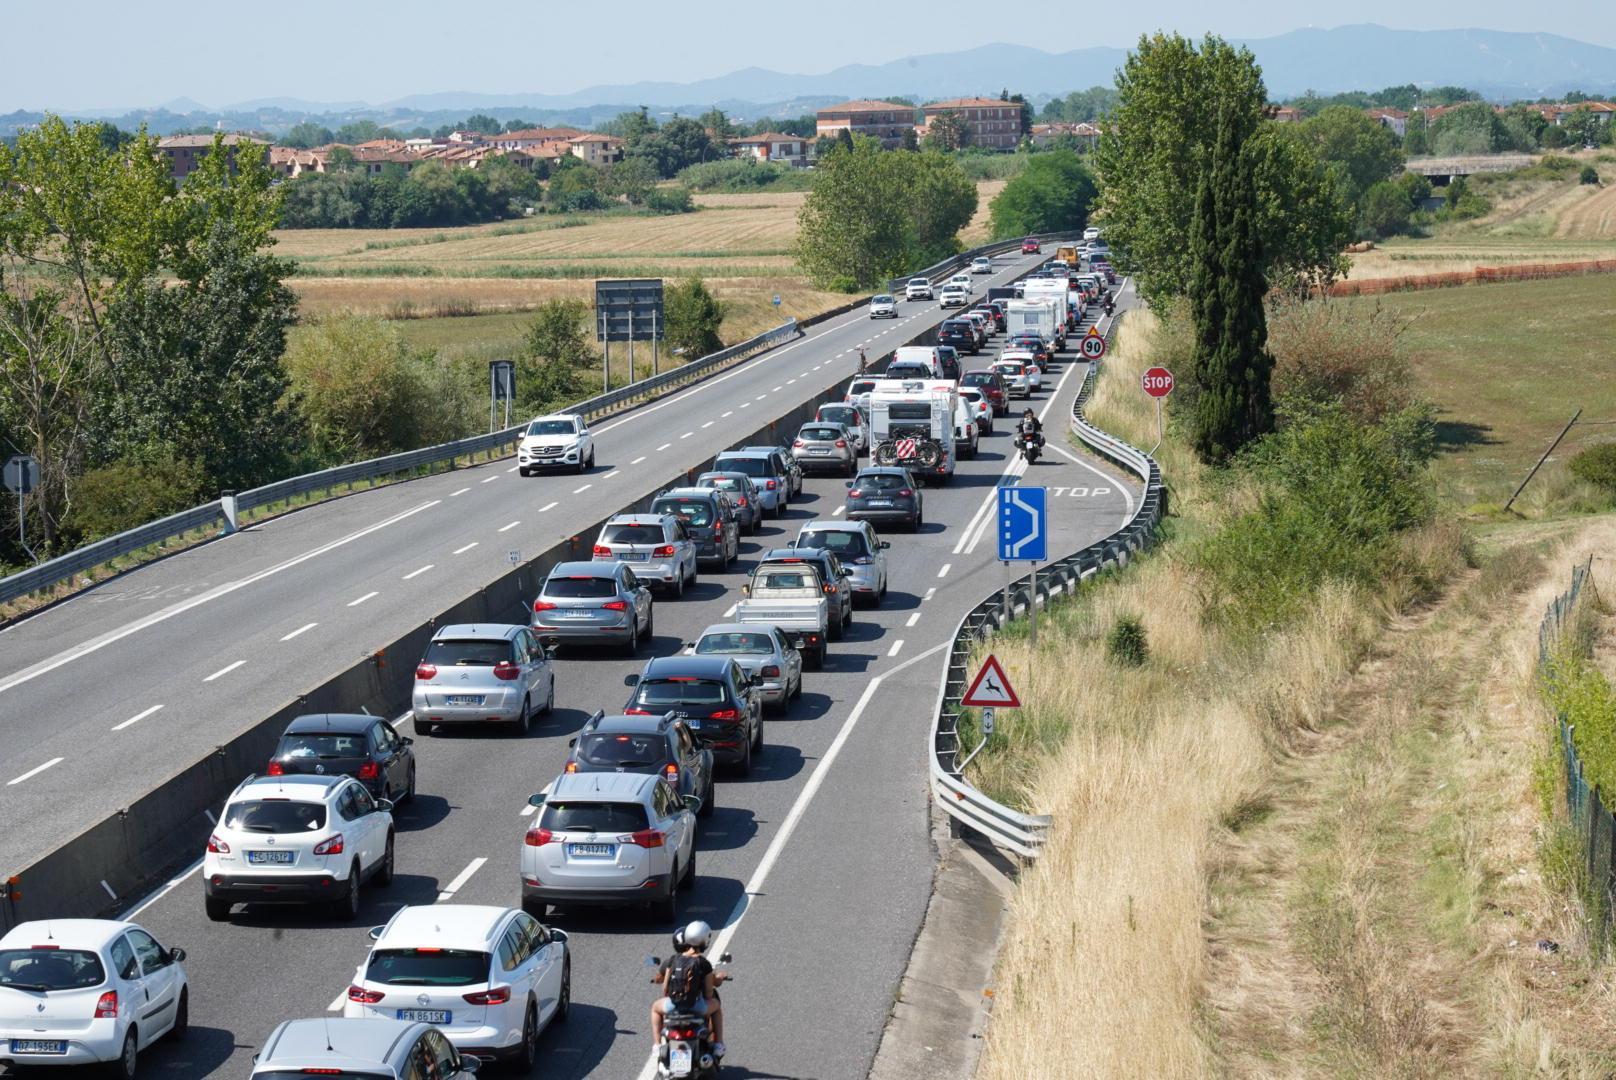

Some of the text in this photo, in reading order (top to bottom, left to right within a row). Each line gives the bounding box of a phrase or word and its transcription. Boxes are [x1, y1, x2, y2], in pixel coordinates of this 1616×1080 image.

[1086, 342, 1101, 353] 90
[1143, 377, 1171, 389] STOP
[1046, 487, 1111, 497] TOP
[403, 1011, 446, 1021] FN 861SK
